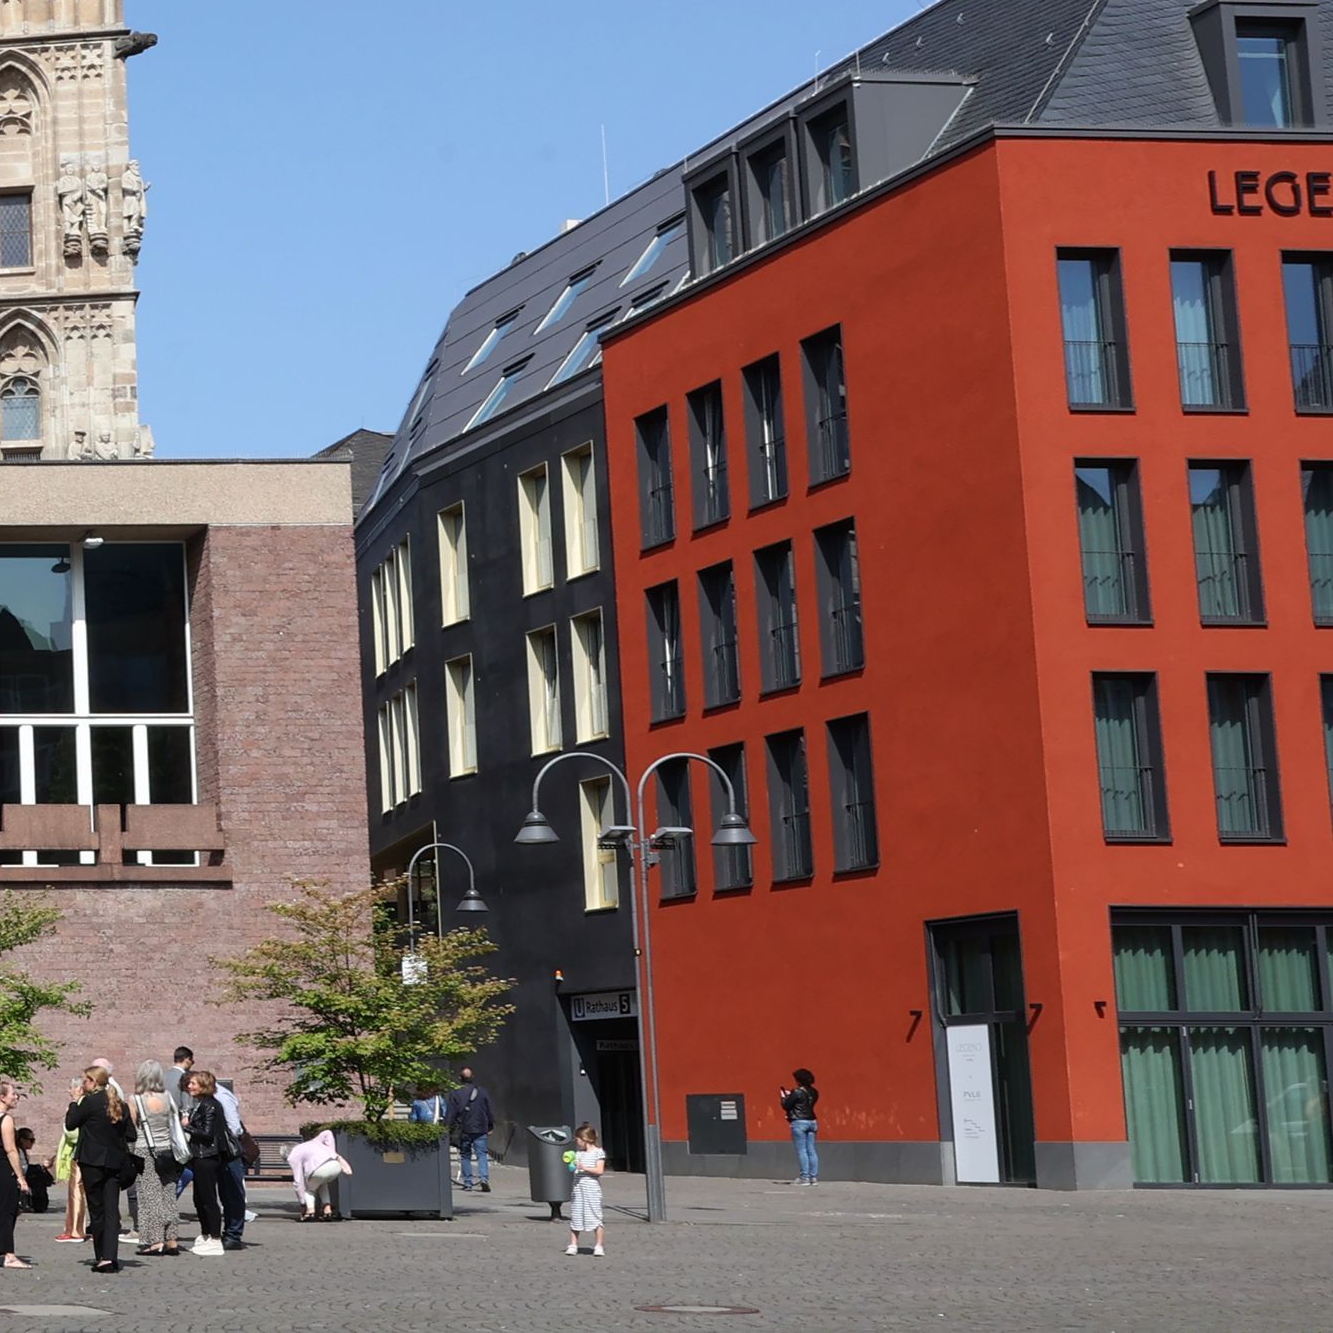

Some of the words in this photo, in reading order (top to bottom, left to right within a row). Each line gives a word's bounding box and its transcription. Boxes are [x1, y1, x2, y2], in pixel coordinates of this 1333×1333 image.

[1208, 170, 1333, 216] LEGE
[574, 998, 585, 1017] U
[586, 1001, 618, 1013] Rathaus
